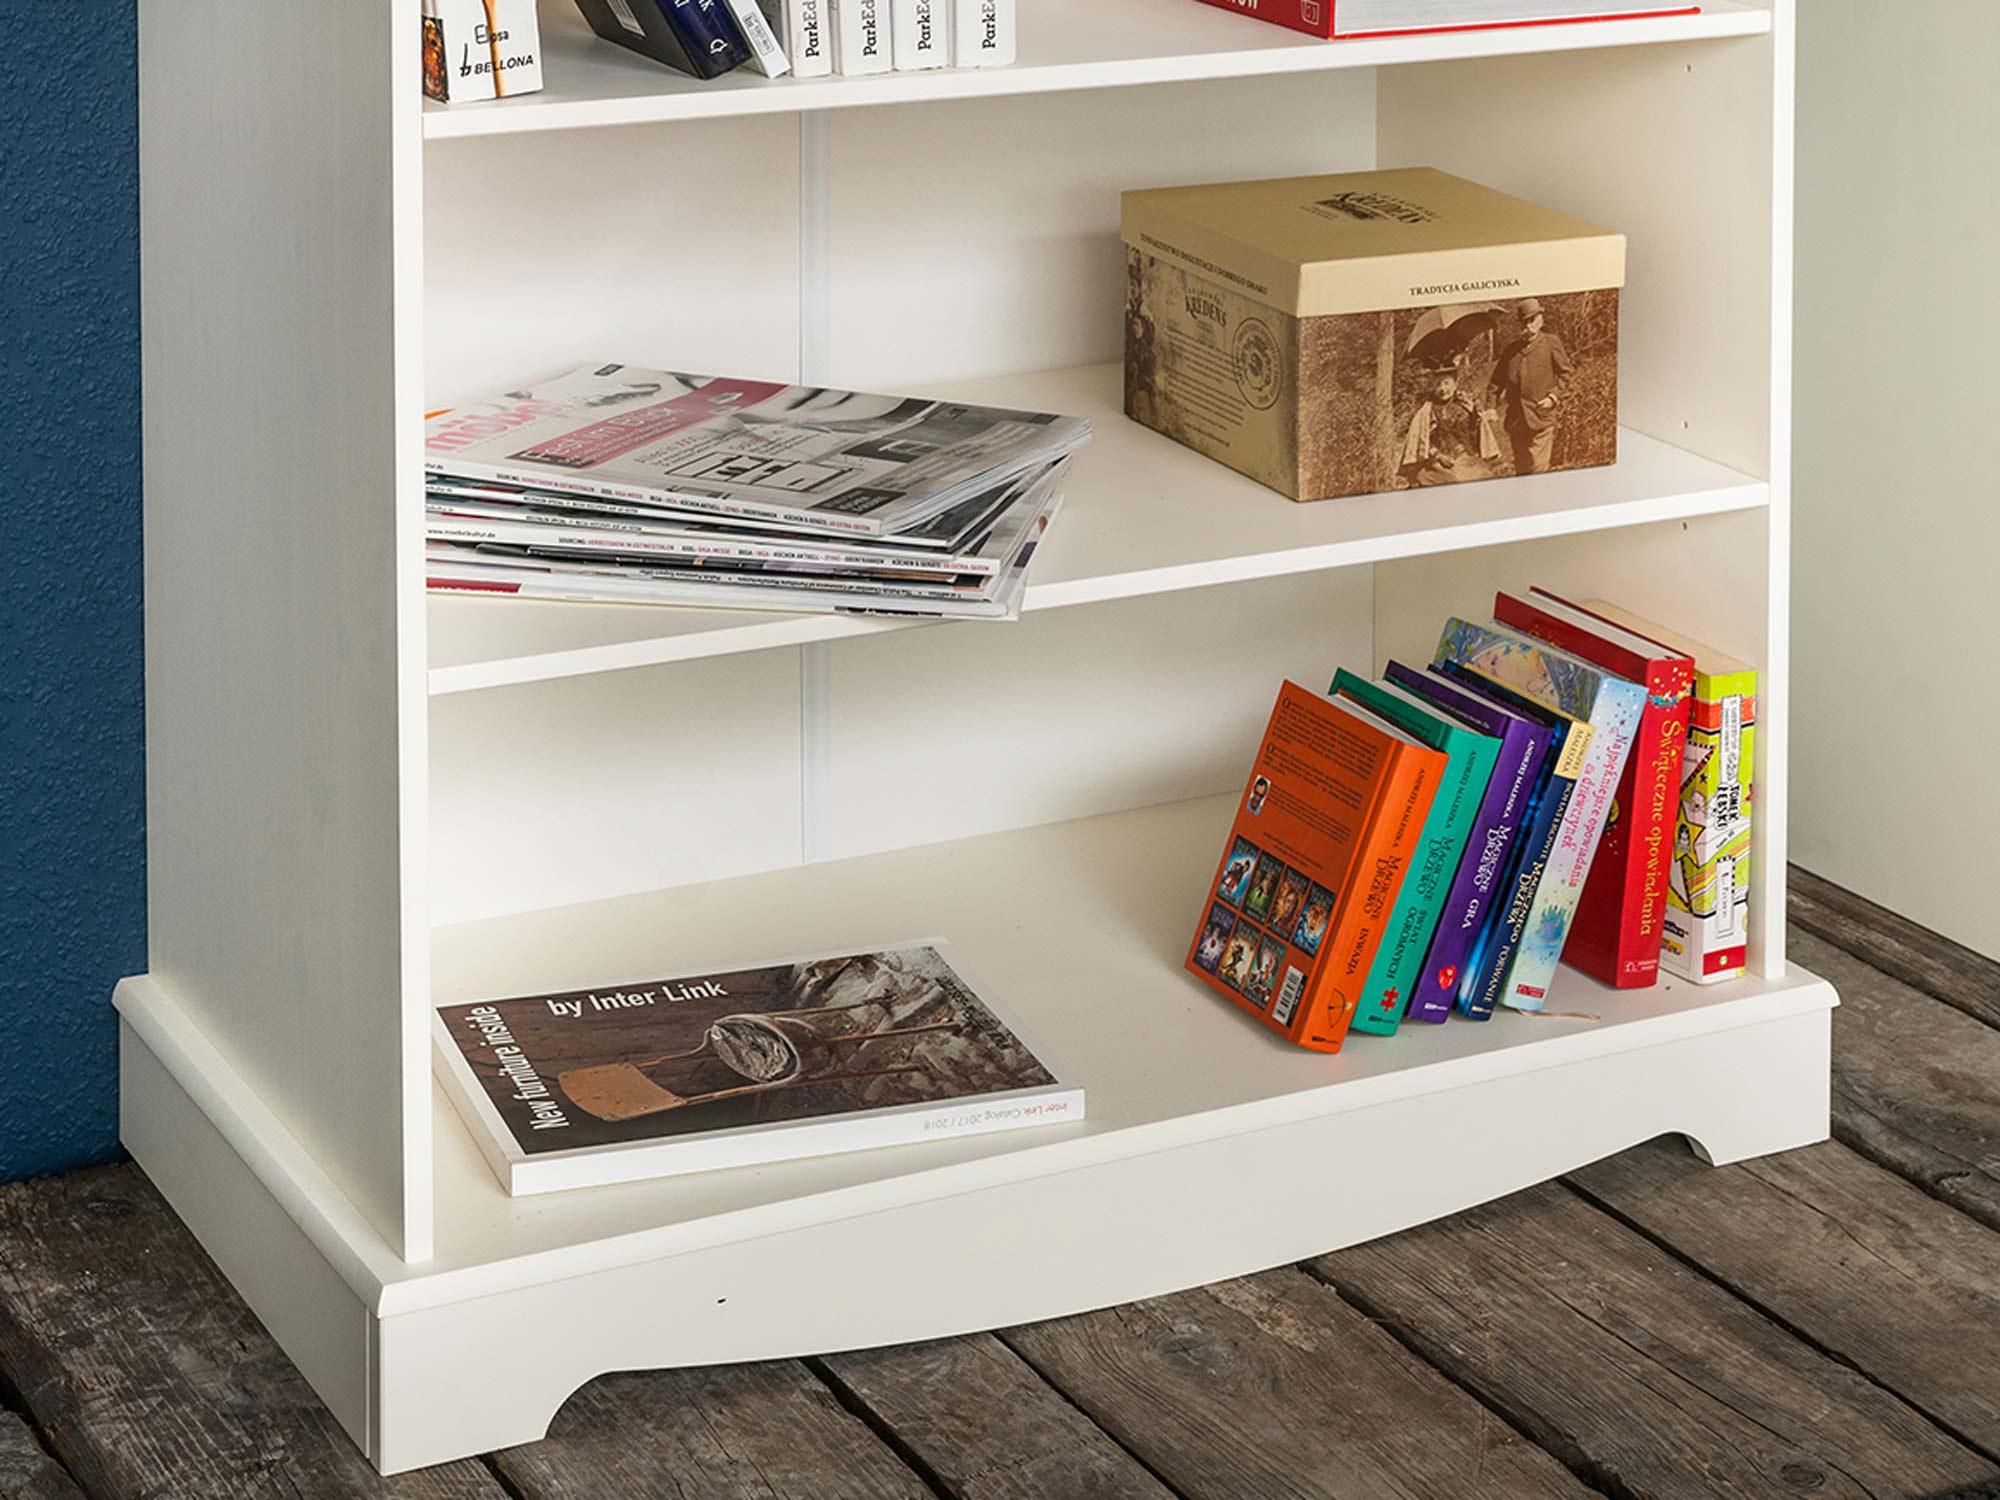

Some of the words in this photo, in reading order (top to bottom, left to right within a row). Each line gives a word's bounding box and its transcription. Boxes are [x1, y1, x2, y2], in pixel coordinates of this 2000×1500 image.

[474, 55, 534, 75] BELLONA
[1409, 284, 1460, 296] TRADYCJA
[1461, 278, 1520, 291] GALICYJSKA
[1184, 295, 1228, 329] KREDENS
[1517, 738, 1535, 775] ANDRZEJ
[1650, 718, 1685, 824] Świąteczne
[1729, 785, 1741, 820] TOMEK
[1416, 839, 1442, 895] DRZEWO
[1473, 828, 1499, 887] DRZEWO
[1568, 817, 1598, 888] opowiadania
[1363, 857, 1389, 914] DRZEWO
[1639, 824, 1667, 936] opowiadania
[1462, 898, 1480, 929] GRA
[1506, 873, 1532, 926] DRZEWA
[1386, 906, 1418, 980] OGROMNYCH
[546, 998, 583, 1018] by
[589, 990, 656, 1012] Inter
[661, 980, 729, 1003] Link
[465, 1004, 516, 1047] inside
[494, 1046, 550, 1100] furniture
[529, 1099, 571, 1132] New
[957, 1114, 982, 1126] 2017
[984, 1108, 1022, 1120] Catalog
[1023, 1106, 1044, 1116] Link
[1045, 1103, 1068, 1112] Inter
[923, 1121, 948, 1132] 2018
